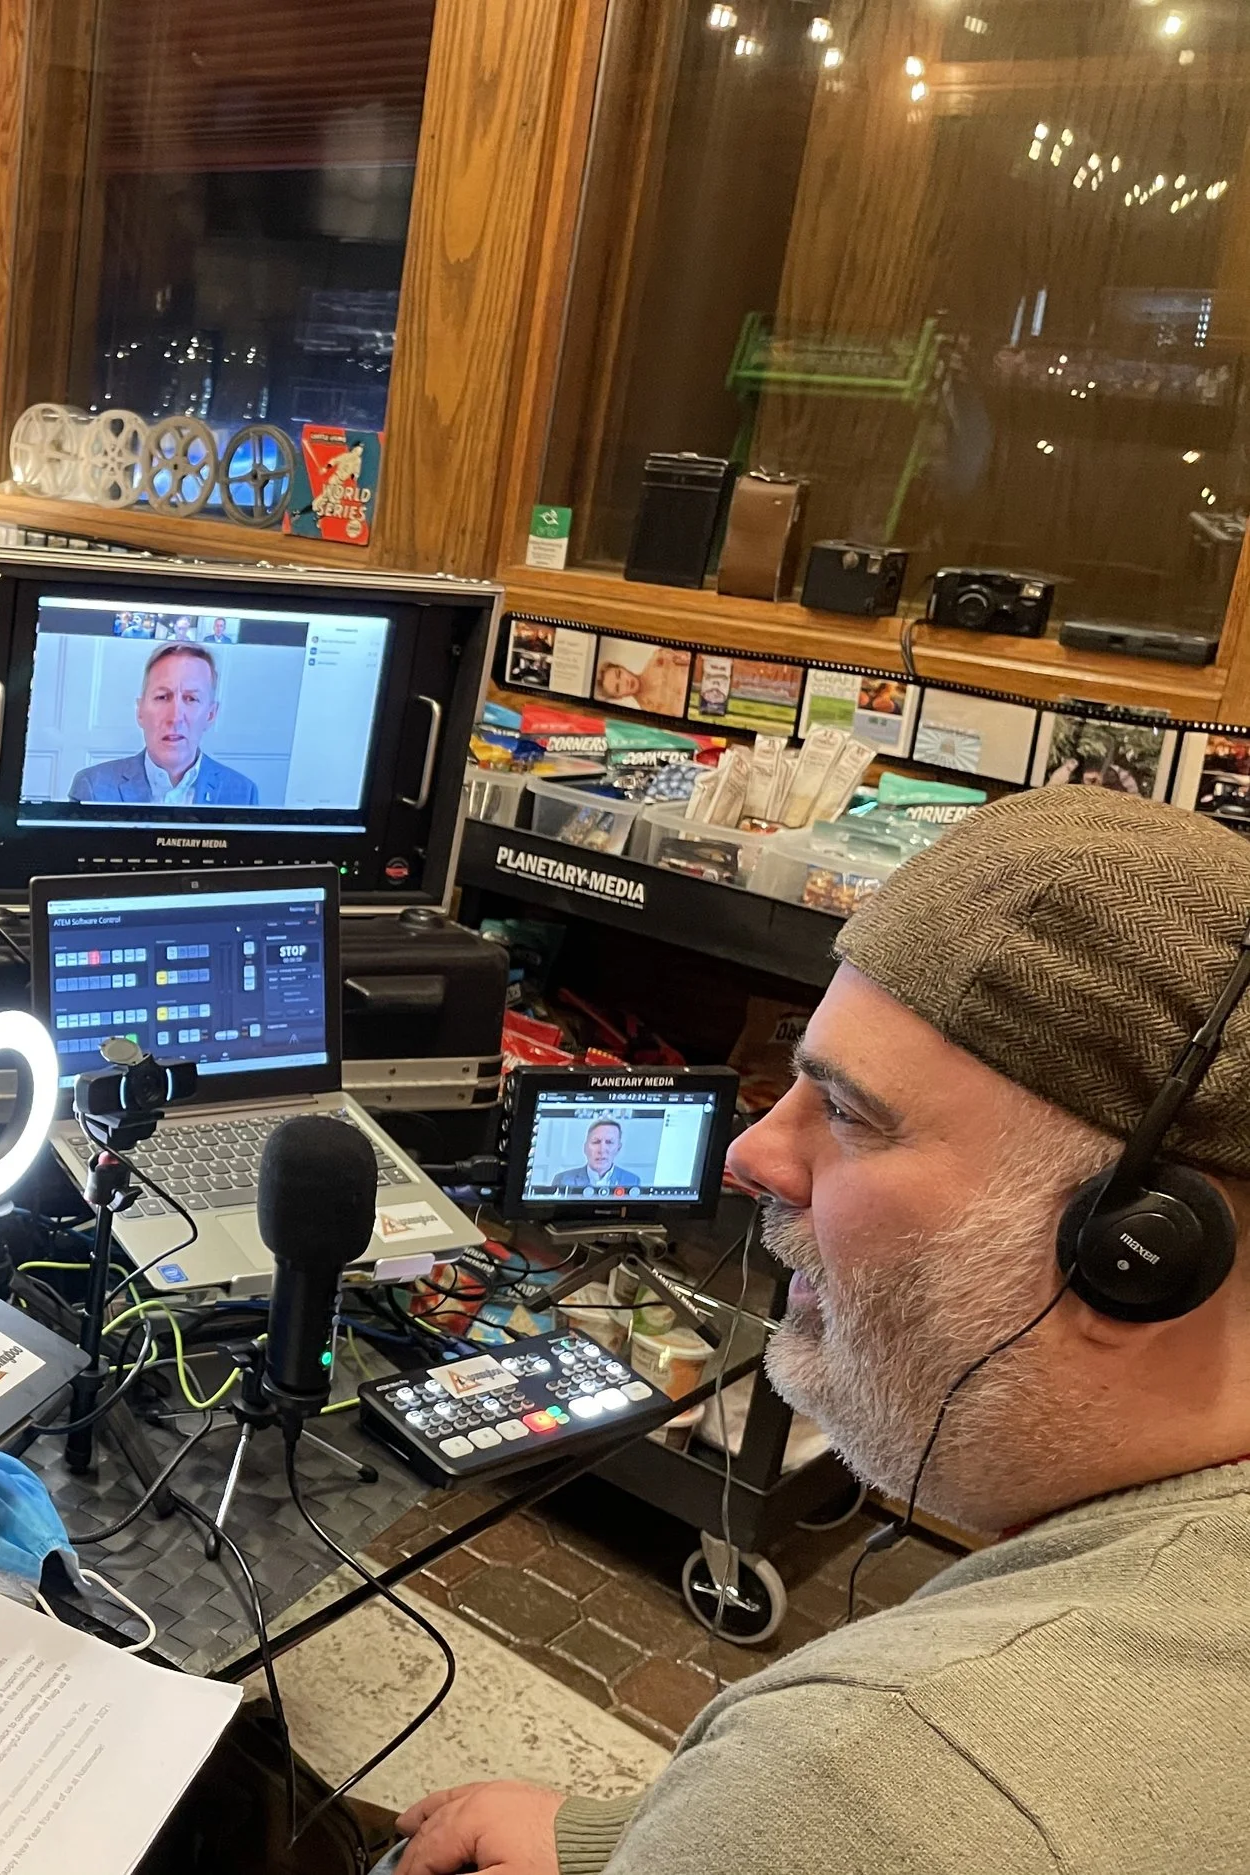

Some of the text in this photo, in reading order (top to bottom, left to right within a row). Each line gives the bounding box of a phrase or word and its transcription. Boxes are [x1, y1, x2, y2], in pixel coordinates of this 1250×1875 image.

[316, 500, 367, 521] SERIES
[546, 736, 609, 752] CORNERS
[156, 837, 228, 849] PLANETARY MEDIA
[53, 915, 121, 927] ATEM Software Control
[279, 945, 307, 957] STOP
[591, 1077, 675, 1087] PLANETARY MEDIA
[1120, 1232, 1161, 1265] maxell
